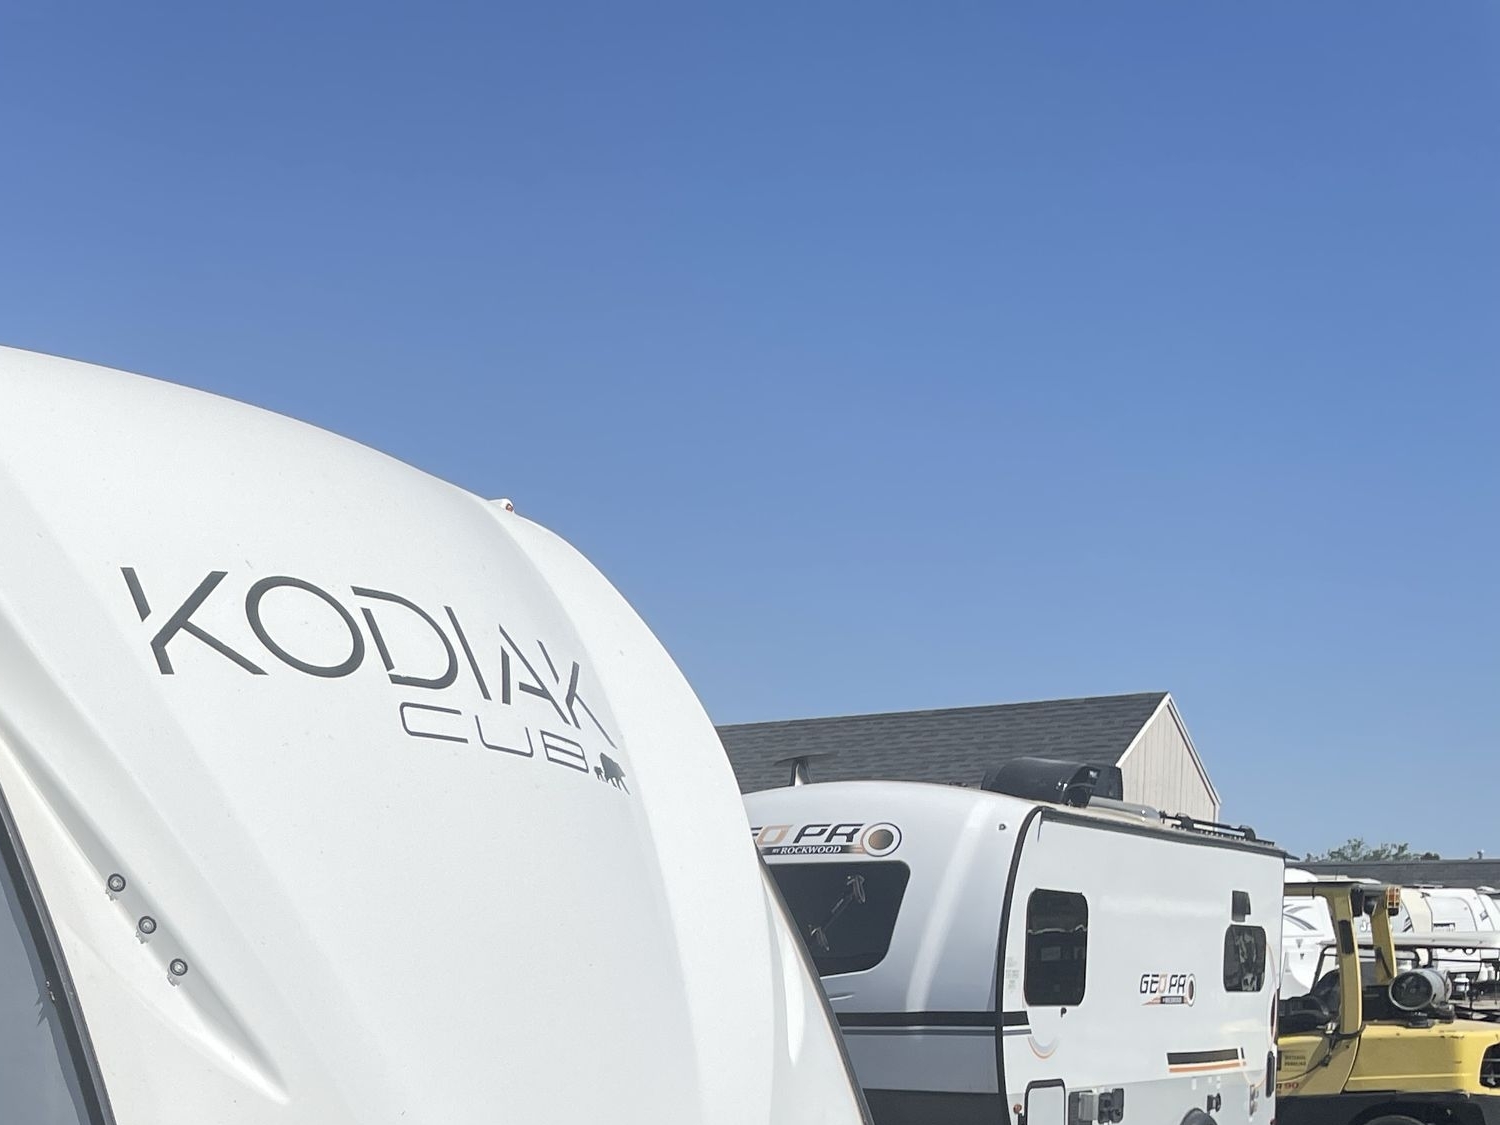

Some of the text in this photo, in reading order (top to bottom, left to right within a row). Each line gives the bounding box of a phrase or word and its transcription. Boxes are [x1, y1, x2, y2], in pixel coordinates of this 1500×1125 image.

[120, 567, 617, 749] KODIAK
[400, 702, 589, 773] CUB
[780, 845, 842, 854] ROCKWOOD
[1140, 974, 1167, 994] GEO
